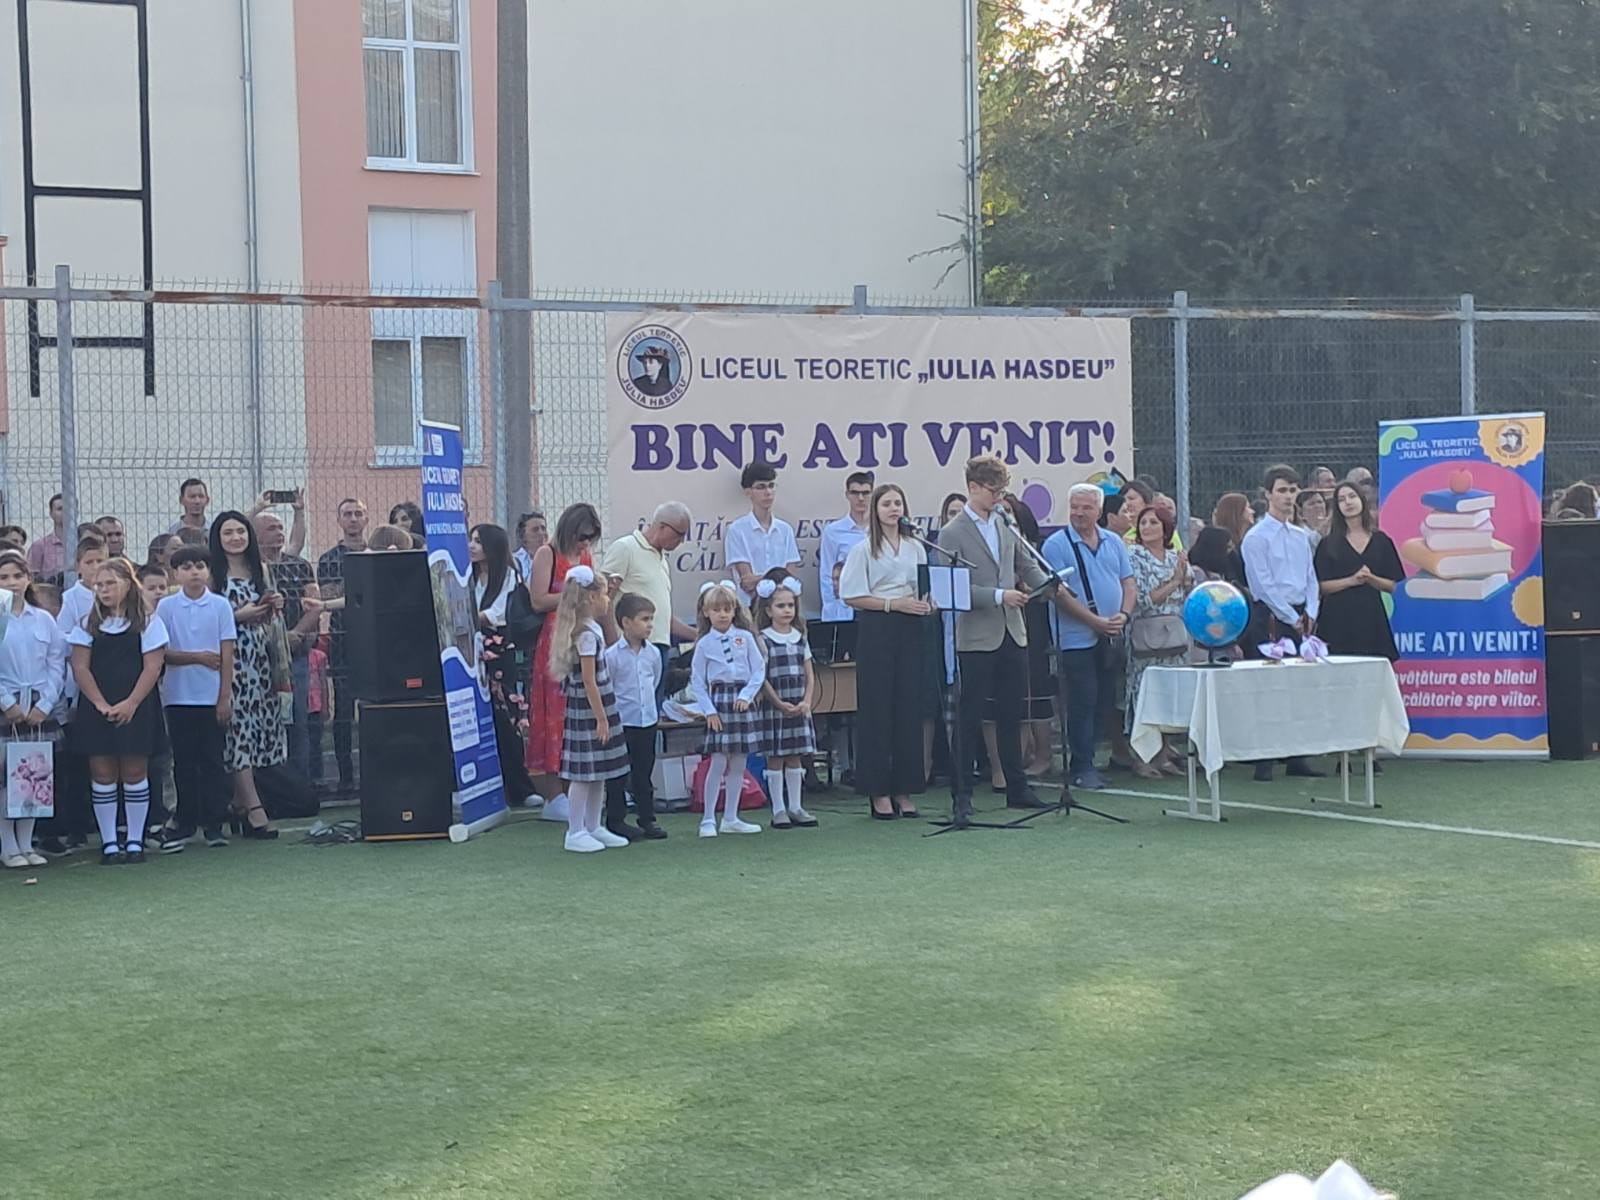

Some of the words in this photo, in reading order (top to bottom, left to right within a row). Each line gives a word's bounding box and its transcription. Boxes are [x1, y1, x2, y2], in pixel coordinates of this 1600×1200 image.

[623, 331, 647, 358] LICEUL
[649, 328, 687, 358] TEORETIC
[700, 357, 788, 380] LICEUL
[794, 358, 912, 380] TEORETIC
[649, 376, 687, 407] HASDEU
[630, 423, 788, 471] BINE
[802, 422, 908, 469] ATI
[921, 420, 1115, 467] VENIT!
[1395, 440, 1430, 450] LICEUL
[1431, 438, 1479, 449] TEORETIC
[1393, 632, 1426, 653] INE
[1471, 630, 1538, 652] VENIT!
[1395, 670, 1458, 689] vățătura
[1460, 669, 1491, 686] este
[1494, 668, 1537, 686] biletul
[1465, 693, 1498, 710] spre
[1501, 690, 1541, 707] viitor.
